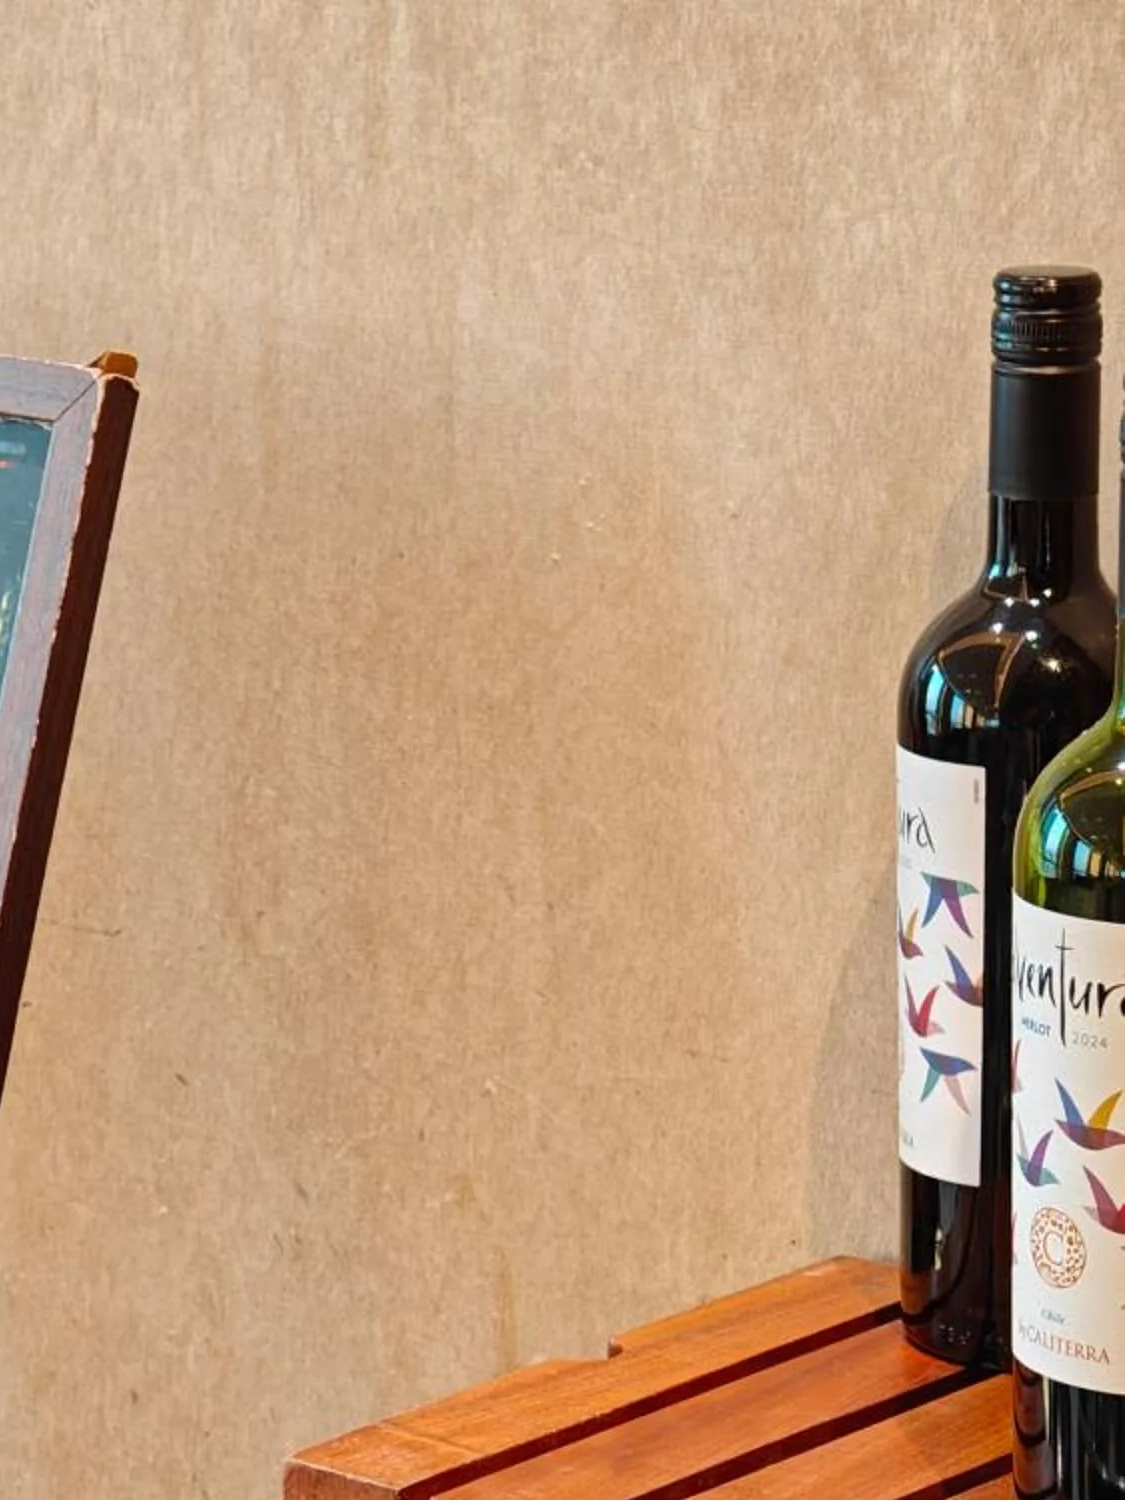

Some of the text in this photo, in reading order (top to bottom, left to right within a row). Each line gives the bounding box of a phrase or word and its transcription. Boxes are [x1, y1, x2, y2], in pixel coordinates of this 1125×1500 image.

[1013, 927, 1125, 1047] ventur
[1070, 1029, 1108, 1050] 2024
[1026, 1325, 1111, 1365] CALITERRA
